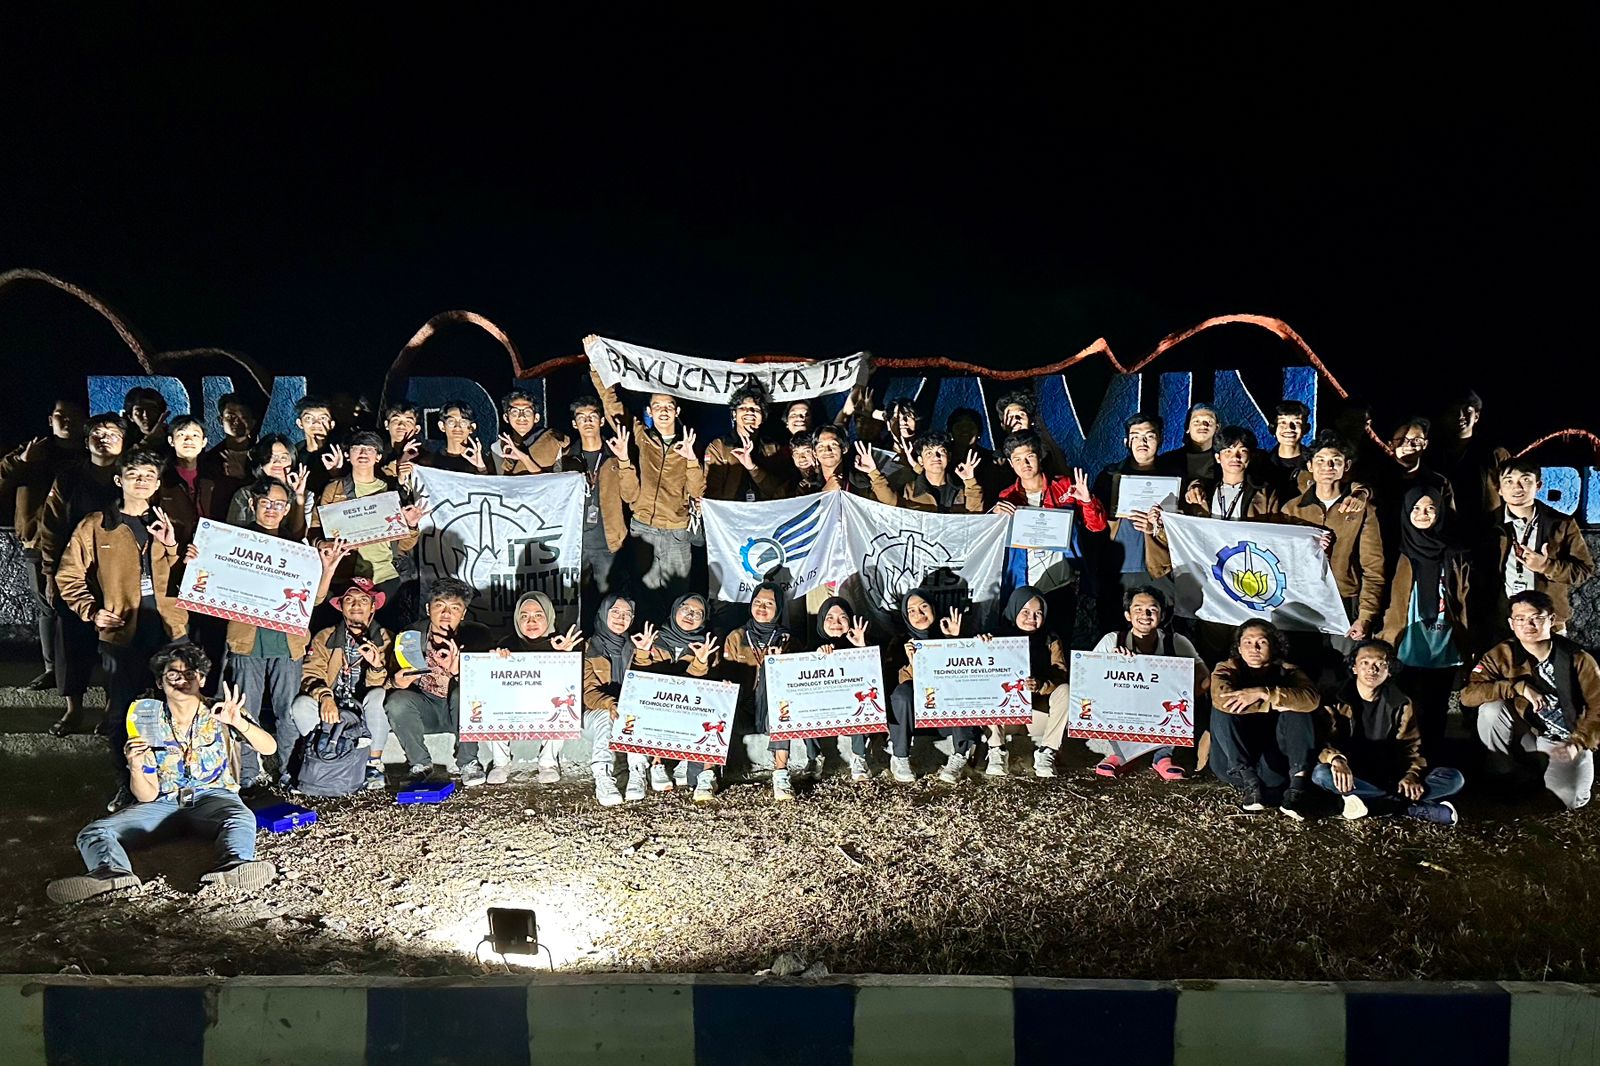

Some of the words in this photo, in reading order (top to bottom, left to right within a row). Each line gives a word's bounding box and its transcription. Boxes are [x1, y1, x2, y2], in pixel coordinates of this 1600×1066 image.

[606, 347, 811, 395] BAYUCARAKA
[819, 356, 861, 388] ITS
[342, 507, 360, 516] BEST
[363, 504, 377, 512] LAP
[229, 546, 272, 566] JUARA
[278, 558, 288, 569] 3
[214, 553, 254, 568] TECHNOLOGY
[255, 564, 301, 580] DEVELOPMENT
[806, 567, 819, 581] ITS
[945, 656, 983, 668] JUARA
[988, 656, 995, 666] 3
[490, 669, 541, 679] HARAPAN
[797, 668, 835, 680] JUARA
[839, 667, 845, 677] 1
[1103, 670, 1145, 682] JUARA
[1150, 673, 1160, 683] 2
[786, 680, 822, 688] TECHNOLOGY
[823, 676, 864, 686] DEVELOPMENT
[652, 691, 690, 704] JUARA
[694, 696, 702, 705] 3
[639, 699, 674, 709] TECHNOLOGY
[675, 704, 716, 714] DEVELOPMENT
